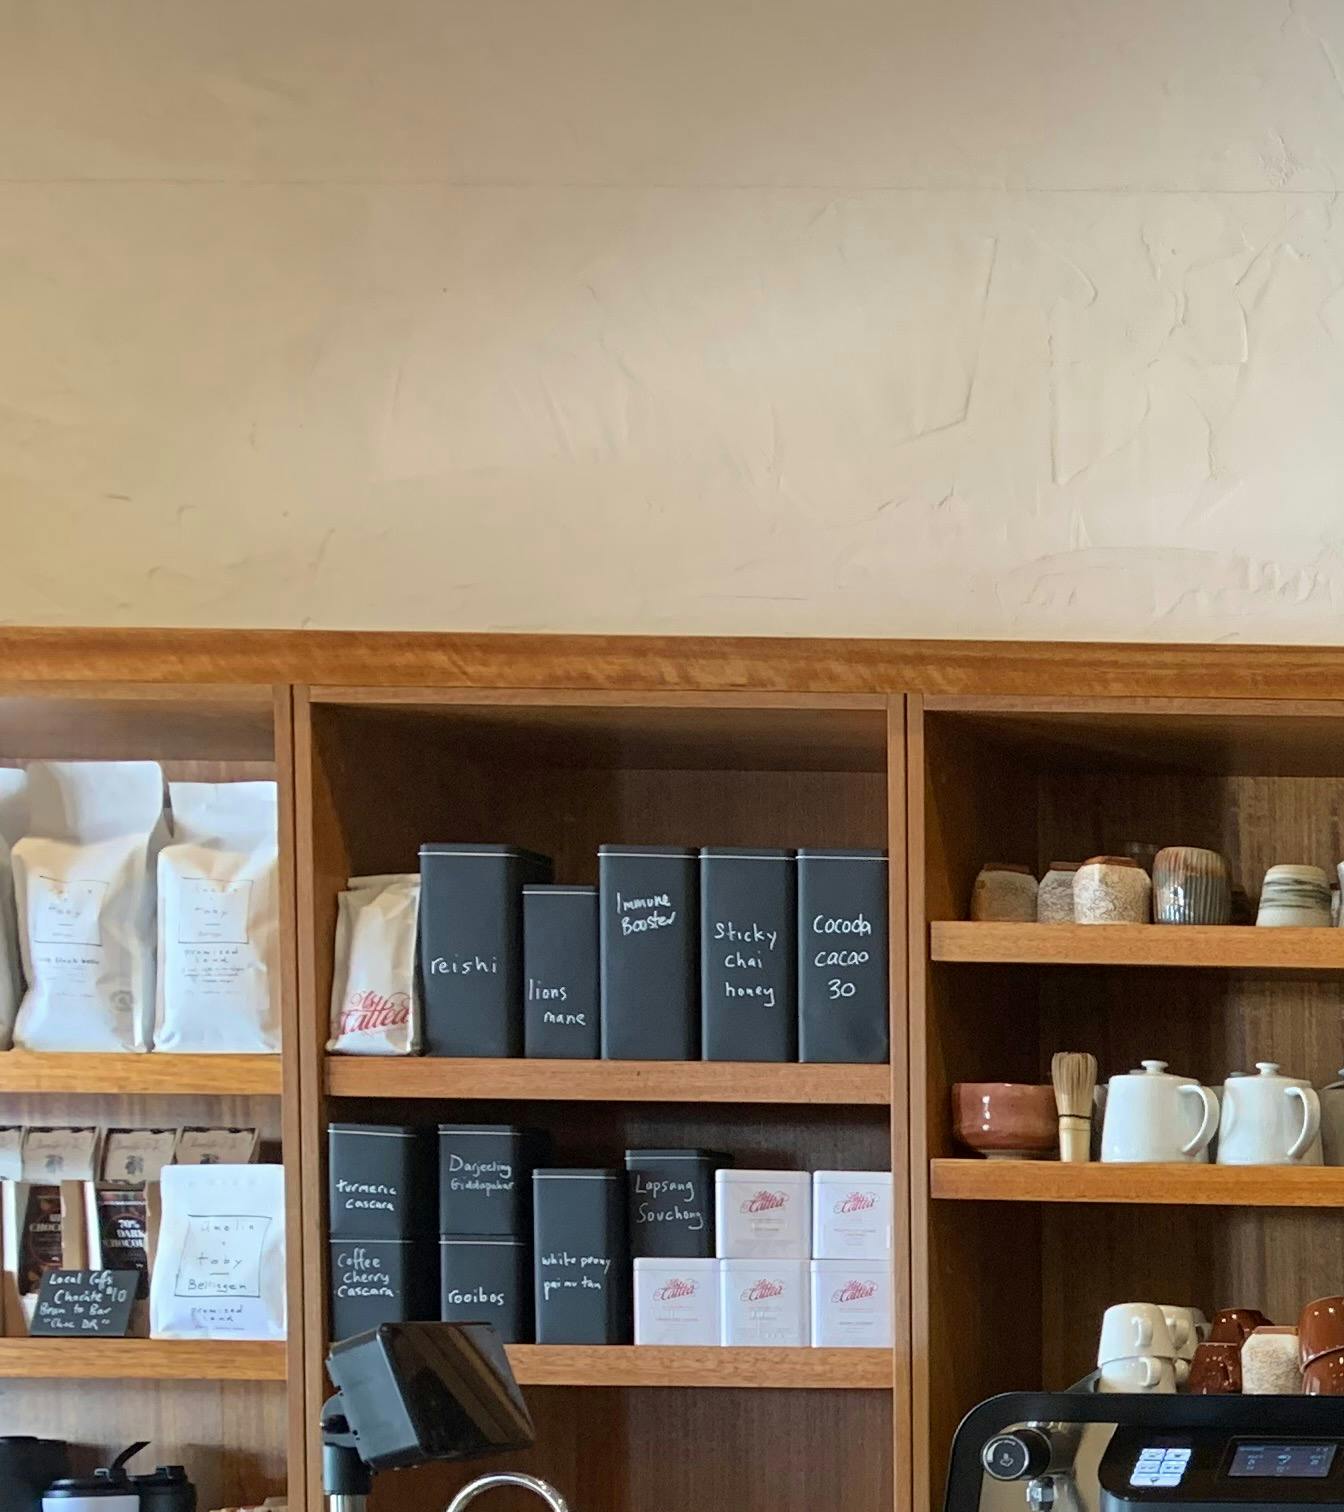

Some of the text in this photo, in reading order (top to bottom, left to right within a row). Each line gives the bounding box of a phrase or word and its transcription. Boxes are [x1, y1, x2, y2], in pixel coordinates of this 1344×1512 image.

[616, 891, 672, 914] Immune
[621, 911, 676, 936] Booster
[812, 913, 872, 937] Cocoda
[713, 921, 777, 950] Sticky
[430, 953, 497, 976] reishi
[528, 978, 568, 1002] lions
[724, 981, 776, 1007] honey
[828, 978, 856, 1000] 30
[543, 1010, 586, 1026] mane
[449, 1154, 512, 1179] Darjeeling
[336, 1179, 397, 1195] turmeric
[635, 1174, 695, 1202] Lapsang
[636, 1202, 704, 1231] Souchong
[197, 1251, 243, 1270] toby
[337, 1247, 381, 1275] Coffee
[541, 1251, 577, 1267] white
[49, 1273, 82, 1285] Local
[448, 1286, 505, 1306] rooibos
[74, 1304, 84, 1313] to
[89, 1303, 112, 1315] Bar
